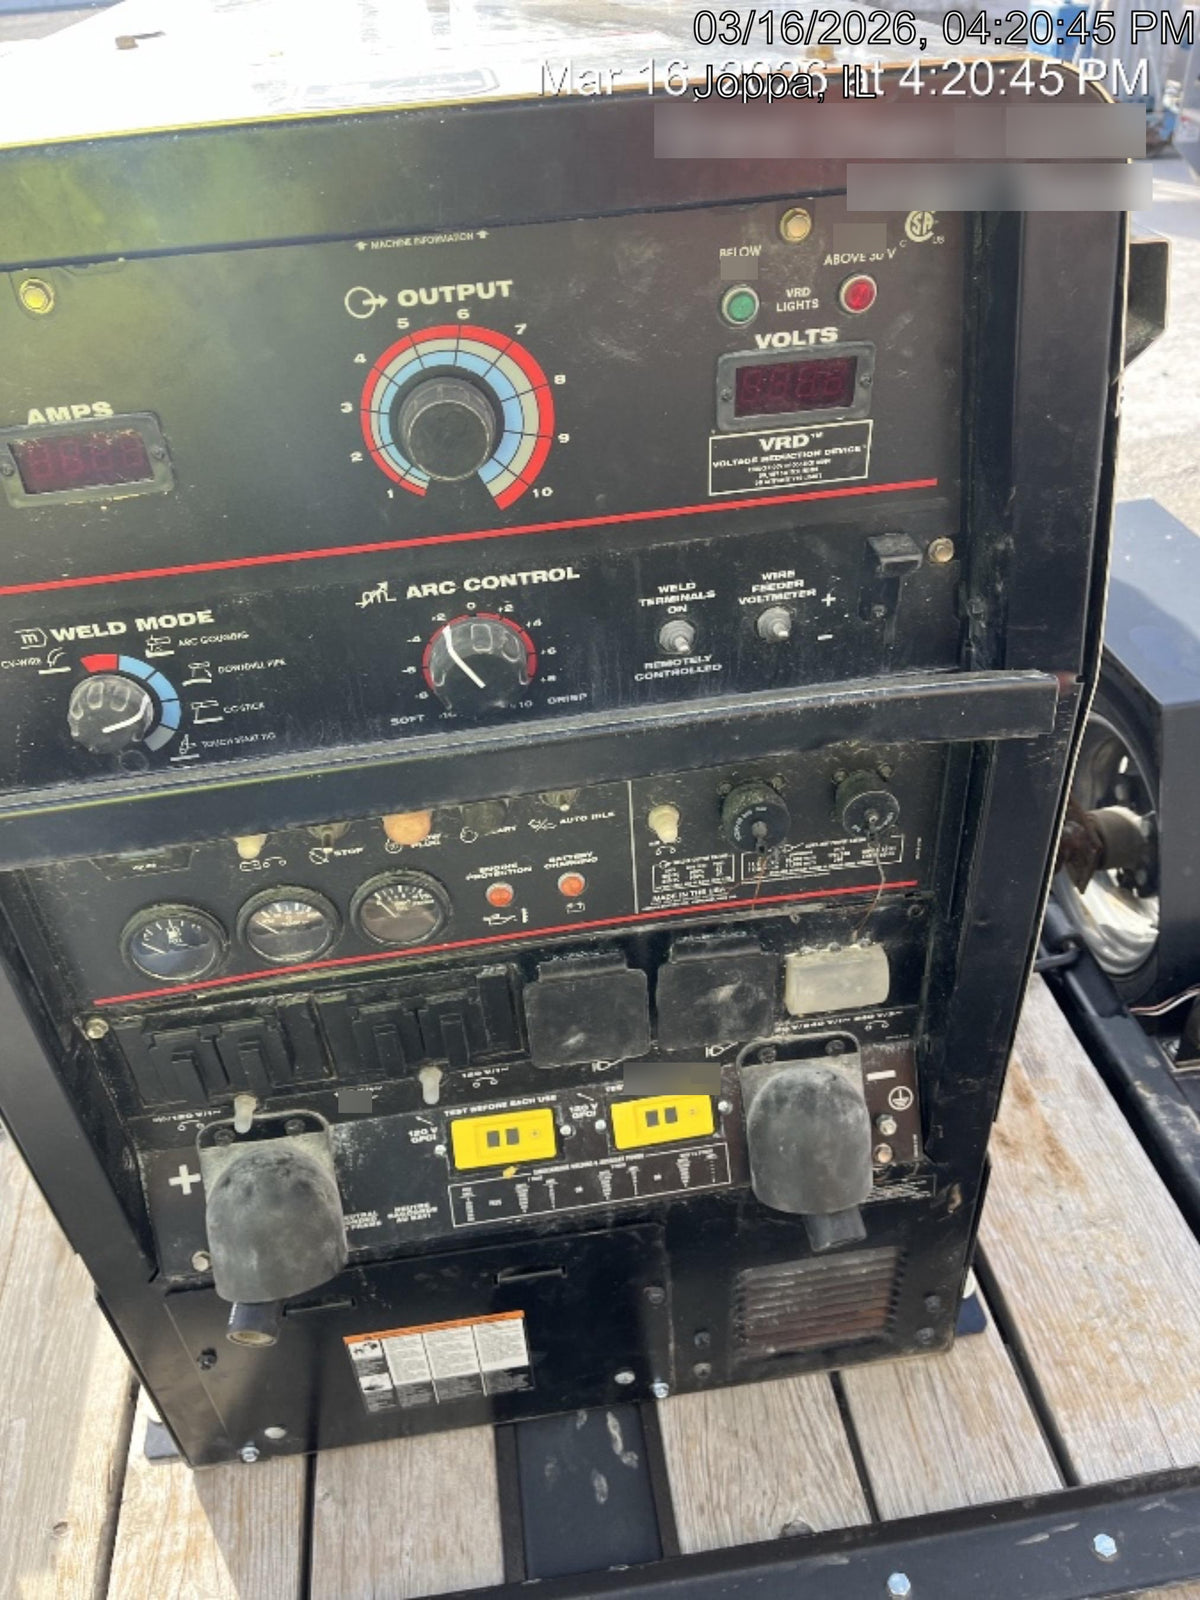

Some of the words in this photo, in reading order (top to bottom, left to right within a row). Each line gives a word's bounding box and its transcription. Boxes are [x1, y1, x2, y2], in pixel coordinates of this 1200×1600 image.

[397, 279, 513, 307] OUTPUT
[786, 287, 812, 298] VRD
[776, 298, 819, 312] LIGHTS
[456, 308, 470, 320] 6
[397, 318, 410, 330] 5
[514, 323, 528, 336] 7
[755, 326, 839, 349] VOLTS
[353, 352, 367, 364] 4
[553, 374, 567, 386] 8
[27, 401, 114, 425] AMPS
[340, 402, 353, 414] 3
[557, 433, 570, 444] 9
[350, 451, 363, 463] 2
[386, 489, 394, 499] 1
[532, 486, 554, 499] 10
[406, 581, 457, 600] ARC
[463, 566, 581, 592] CONTROL
[657, 581, 697, 594] WELD
[638, 589, 717, 608] TERMINALS
[738, 588, 817, 606] VOLTMETER
[466, 602, 476, 611] 0
[667, 603, 688, 615] ON
[50, 621, 128, 643] WELD
[134, 609, 215, 632] MODE
[559, 815, 588, 825] AUTO
[443, 1106, 467, 1117] TEST
[469, 1102, 508, 1113] BEFORE
